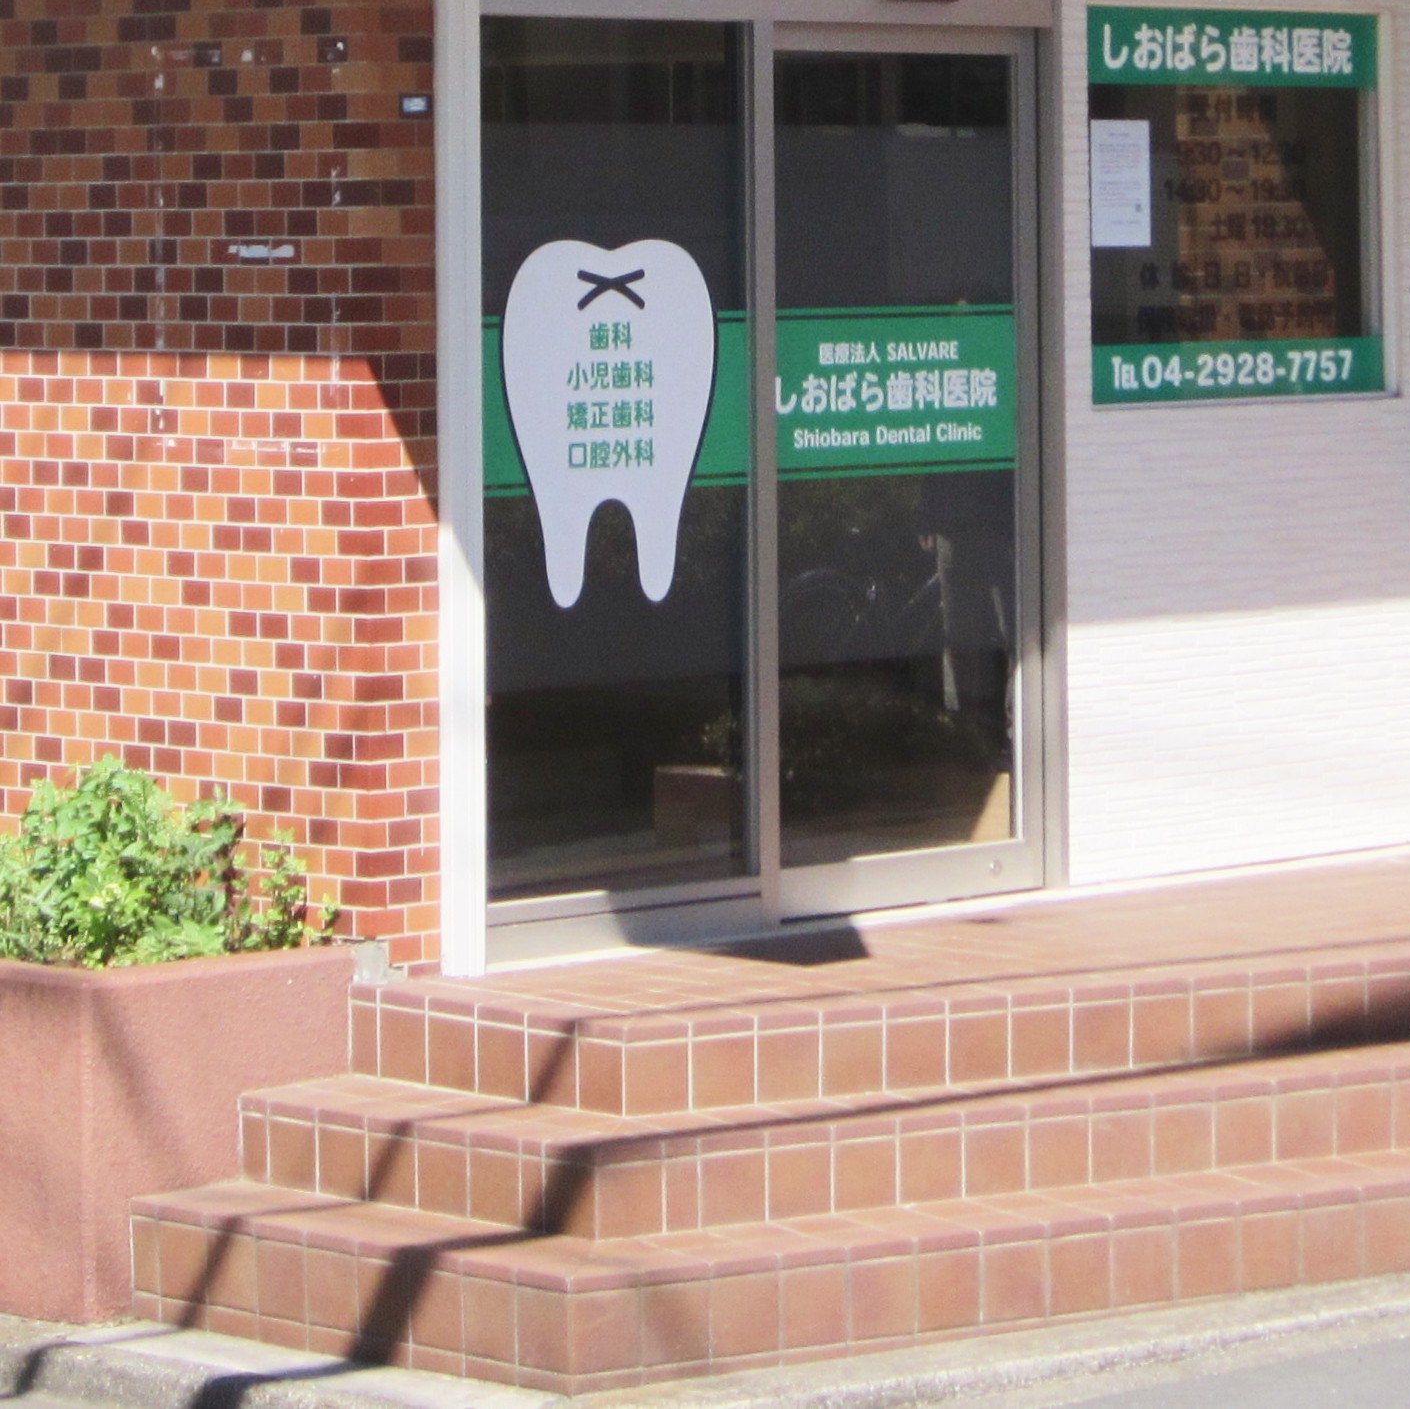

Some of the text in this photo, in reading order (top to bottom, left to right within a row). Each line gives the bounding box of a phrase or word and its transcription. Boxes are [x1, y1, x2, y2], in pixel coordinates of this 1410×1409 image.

[1103, 22, 1353, 74] しおばら歯科医院
[589, 321, 632, 350] 歯科
[819, 341, 959, 365] 医療法人 SALVARE
[566, 360, 654, 391] 小児歯科
[774, 368, 997, 414] しおばら歯科医院
[566, 399, 654, 430] 矯正歯科
[793, 421, 982, 449] Shiobara Dental Clinic
[567, 438, 654, 469] 口腔外科
